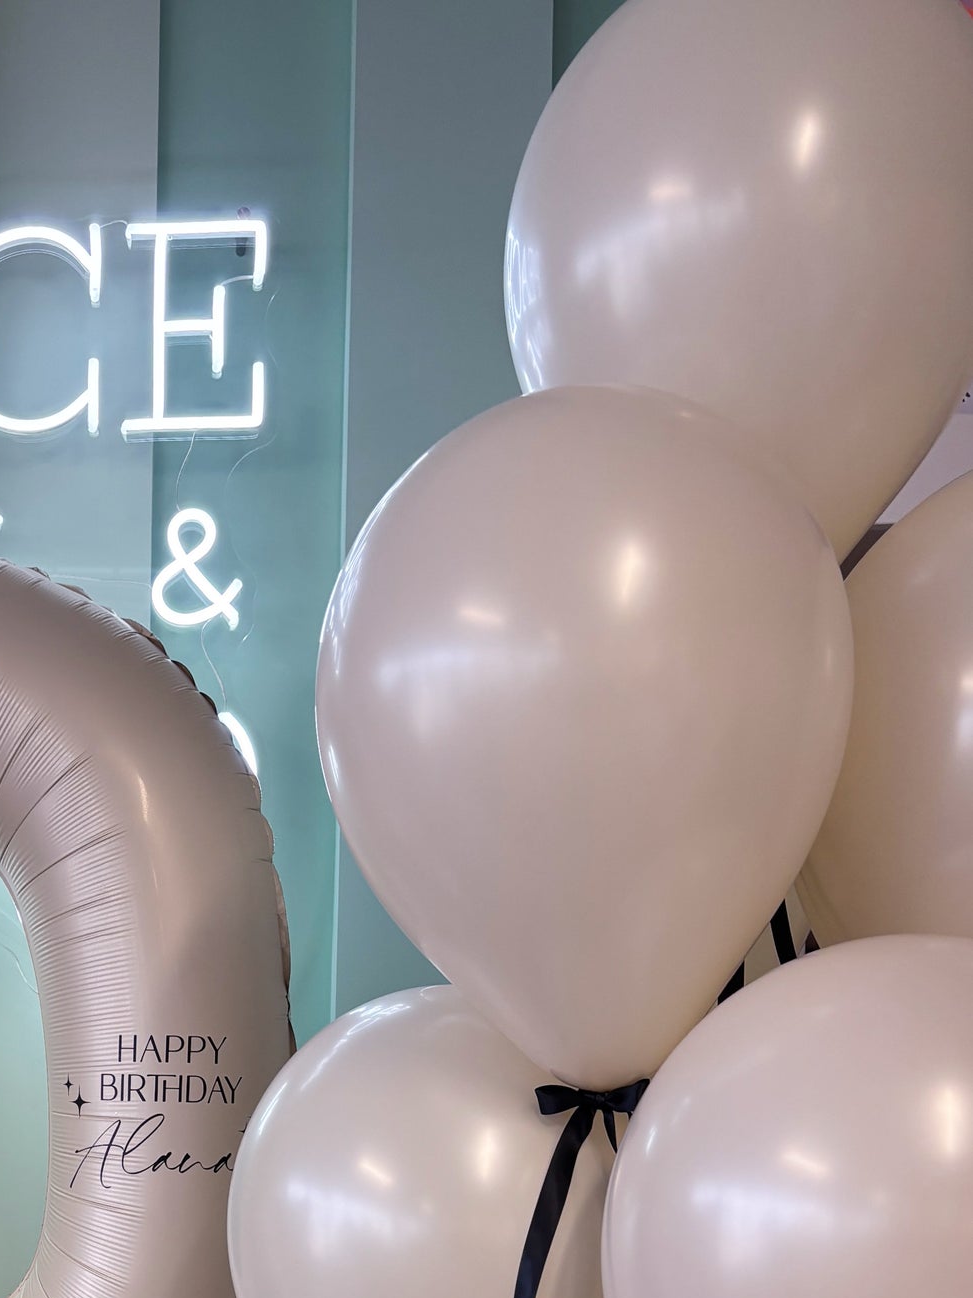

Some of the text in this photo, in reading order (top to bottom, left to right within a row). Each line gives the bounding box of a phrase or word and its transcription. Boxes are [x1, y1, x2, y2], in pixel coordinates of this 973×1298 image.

[151, 507, 243, 630] &
[117, 1034, 227, 1064] HAPPY
[100, 1073, 243, 1104] BIRTHDAY
